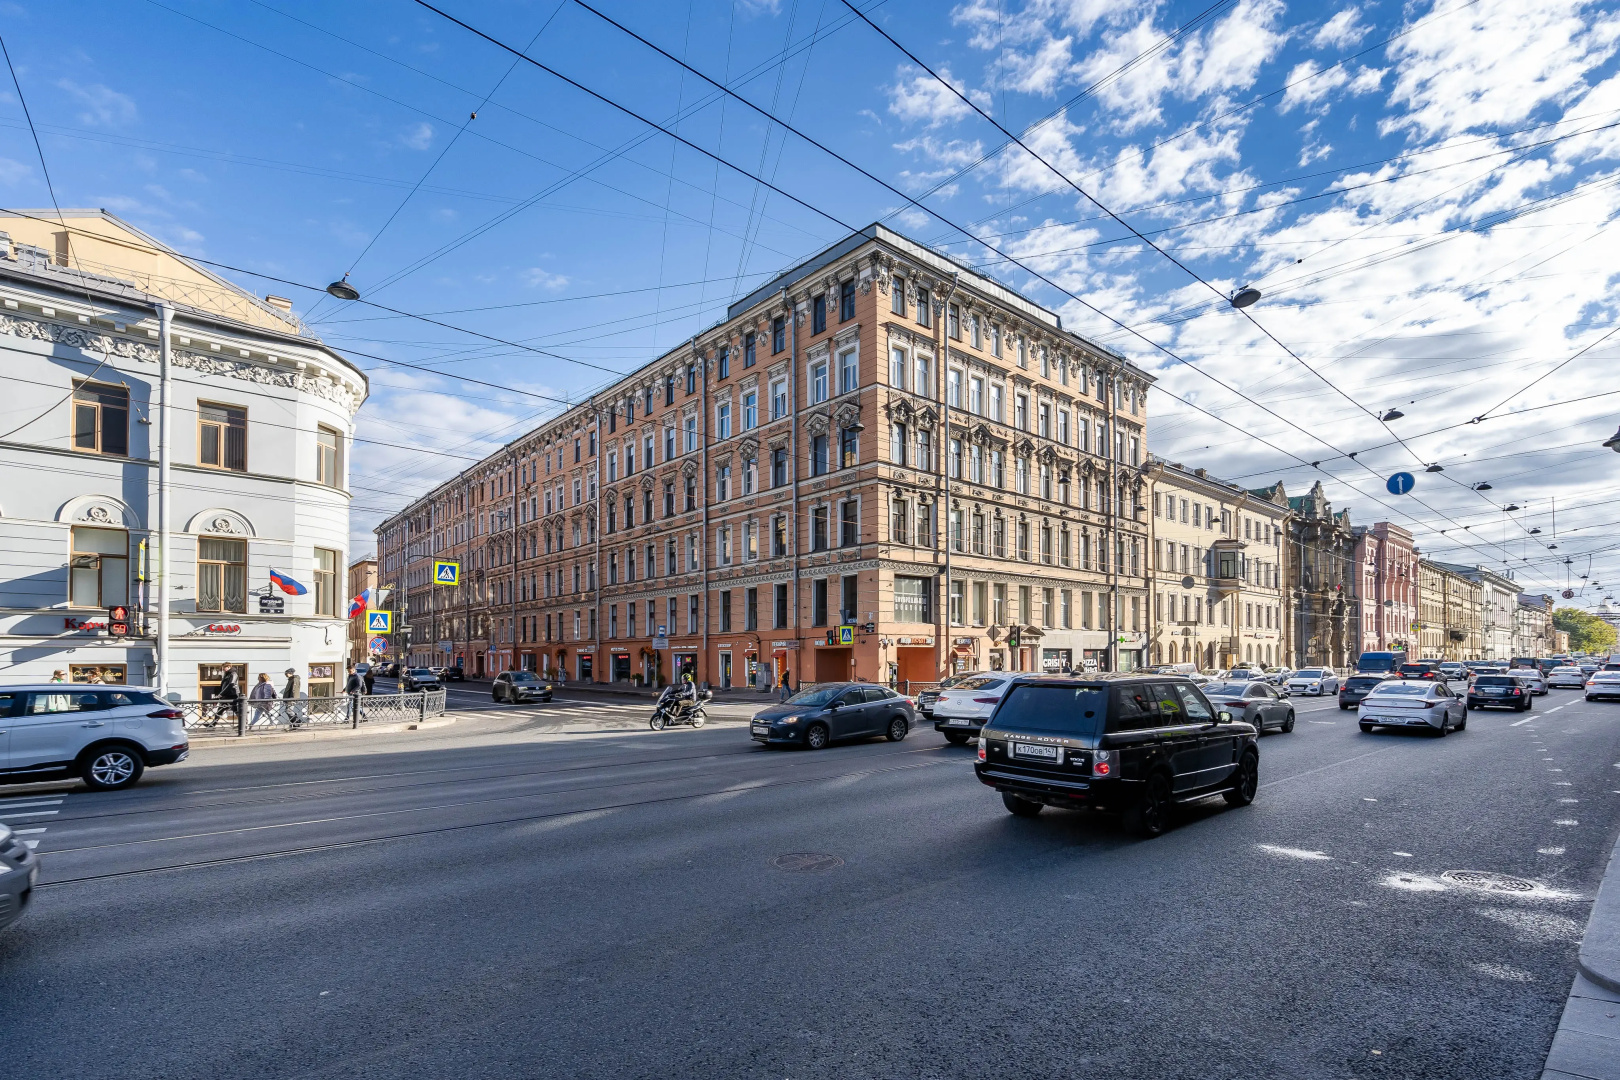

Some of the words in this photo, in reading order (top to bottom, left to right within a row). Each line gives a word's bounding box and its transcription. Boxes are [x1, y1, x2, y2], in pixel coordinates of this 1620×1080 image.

[64, 618, 109, 632] Корч
[112, 624, 127, 634] 59
[1003, 732, 1031, 740] RANGE
